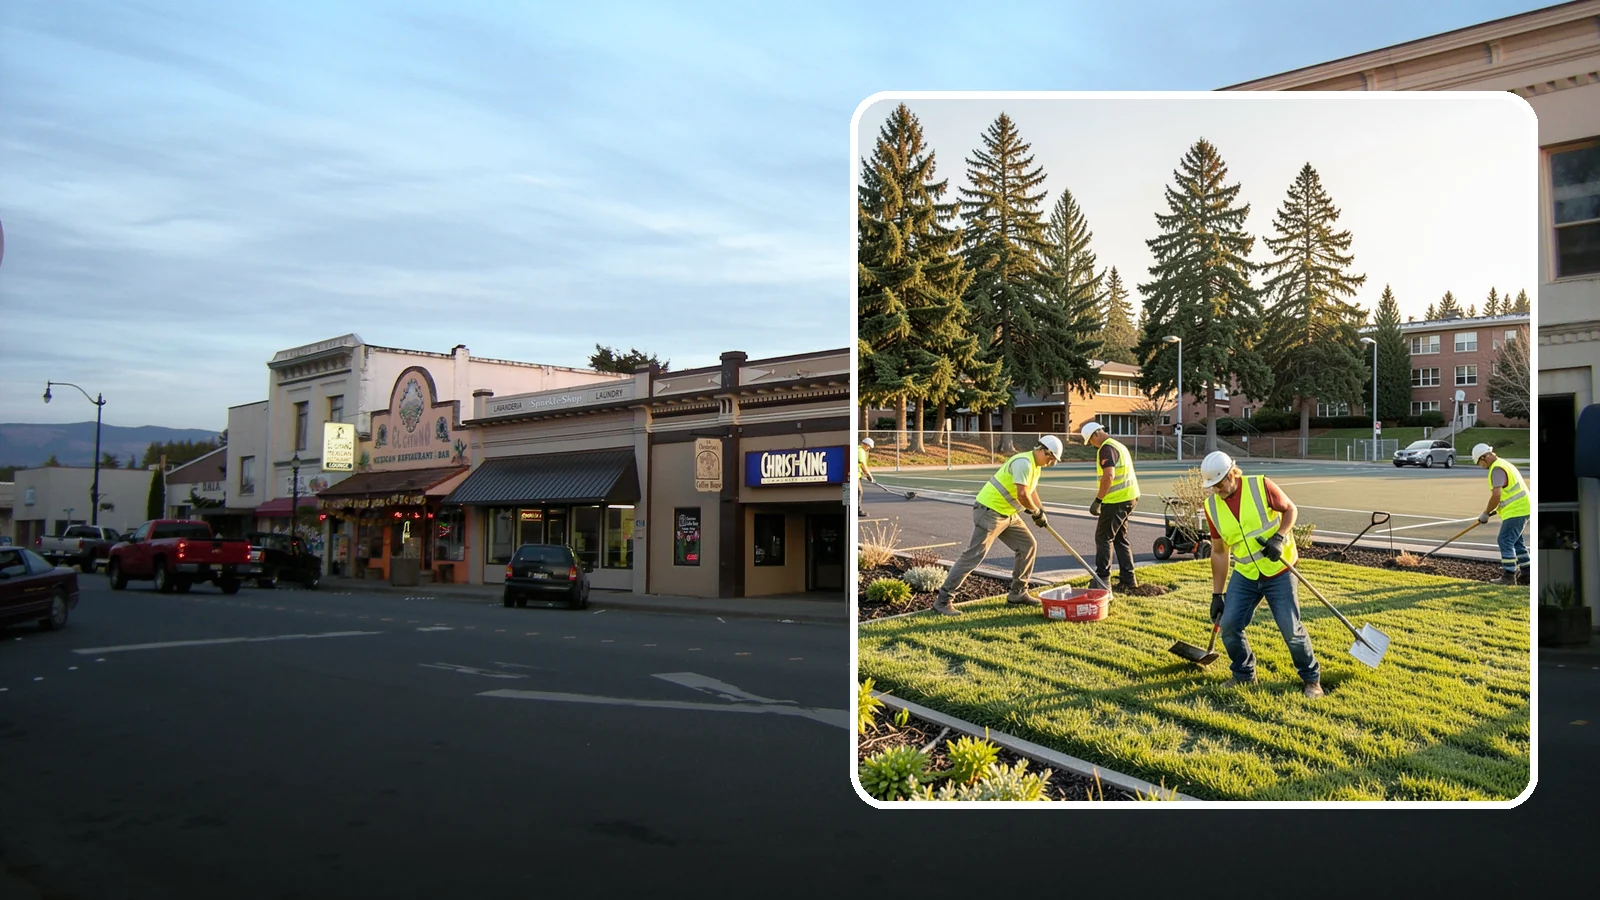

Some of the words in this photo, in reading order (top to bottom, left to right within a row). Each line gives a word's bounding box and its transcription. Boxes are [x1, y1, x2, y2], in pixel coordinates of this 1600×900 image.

[530, 396, 560, 409] Sparkle
[561, 394, 582, 406] Shop
[595, 389, 624, 400] LAUNDRY
[493, 402, 523, 412] LAVANDERIA
[374, 455, 396, 464] MEXICAN
[397, 451, 433, 463] RESTAURANT
[438, 450, 450, 459] BAR
[761, 452, 797, 478] CHRIST
[799, 450, 827, 476] KING
